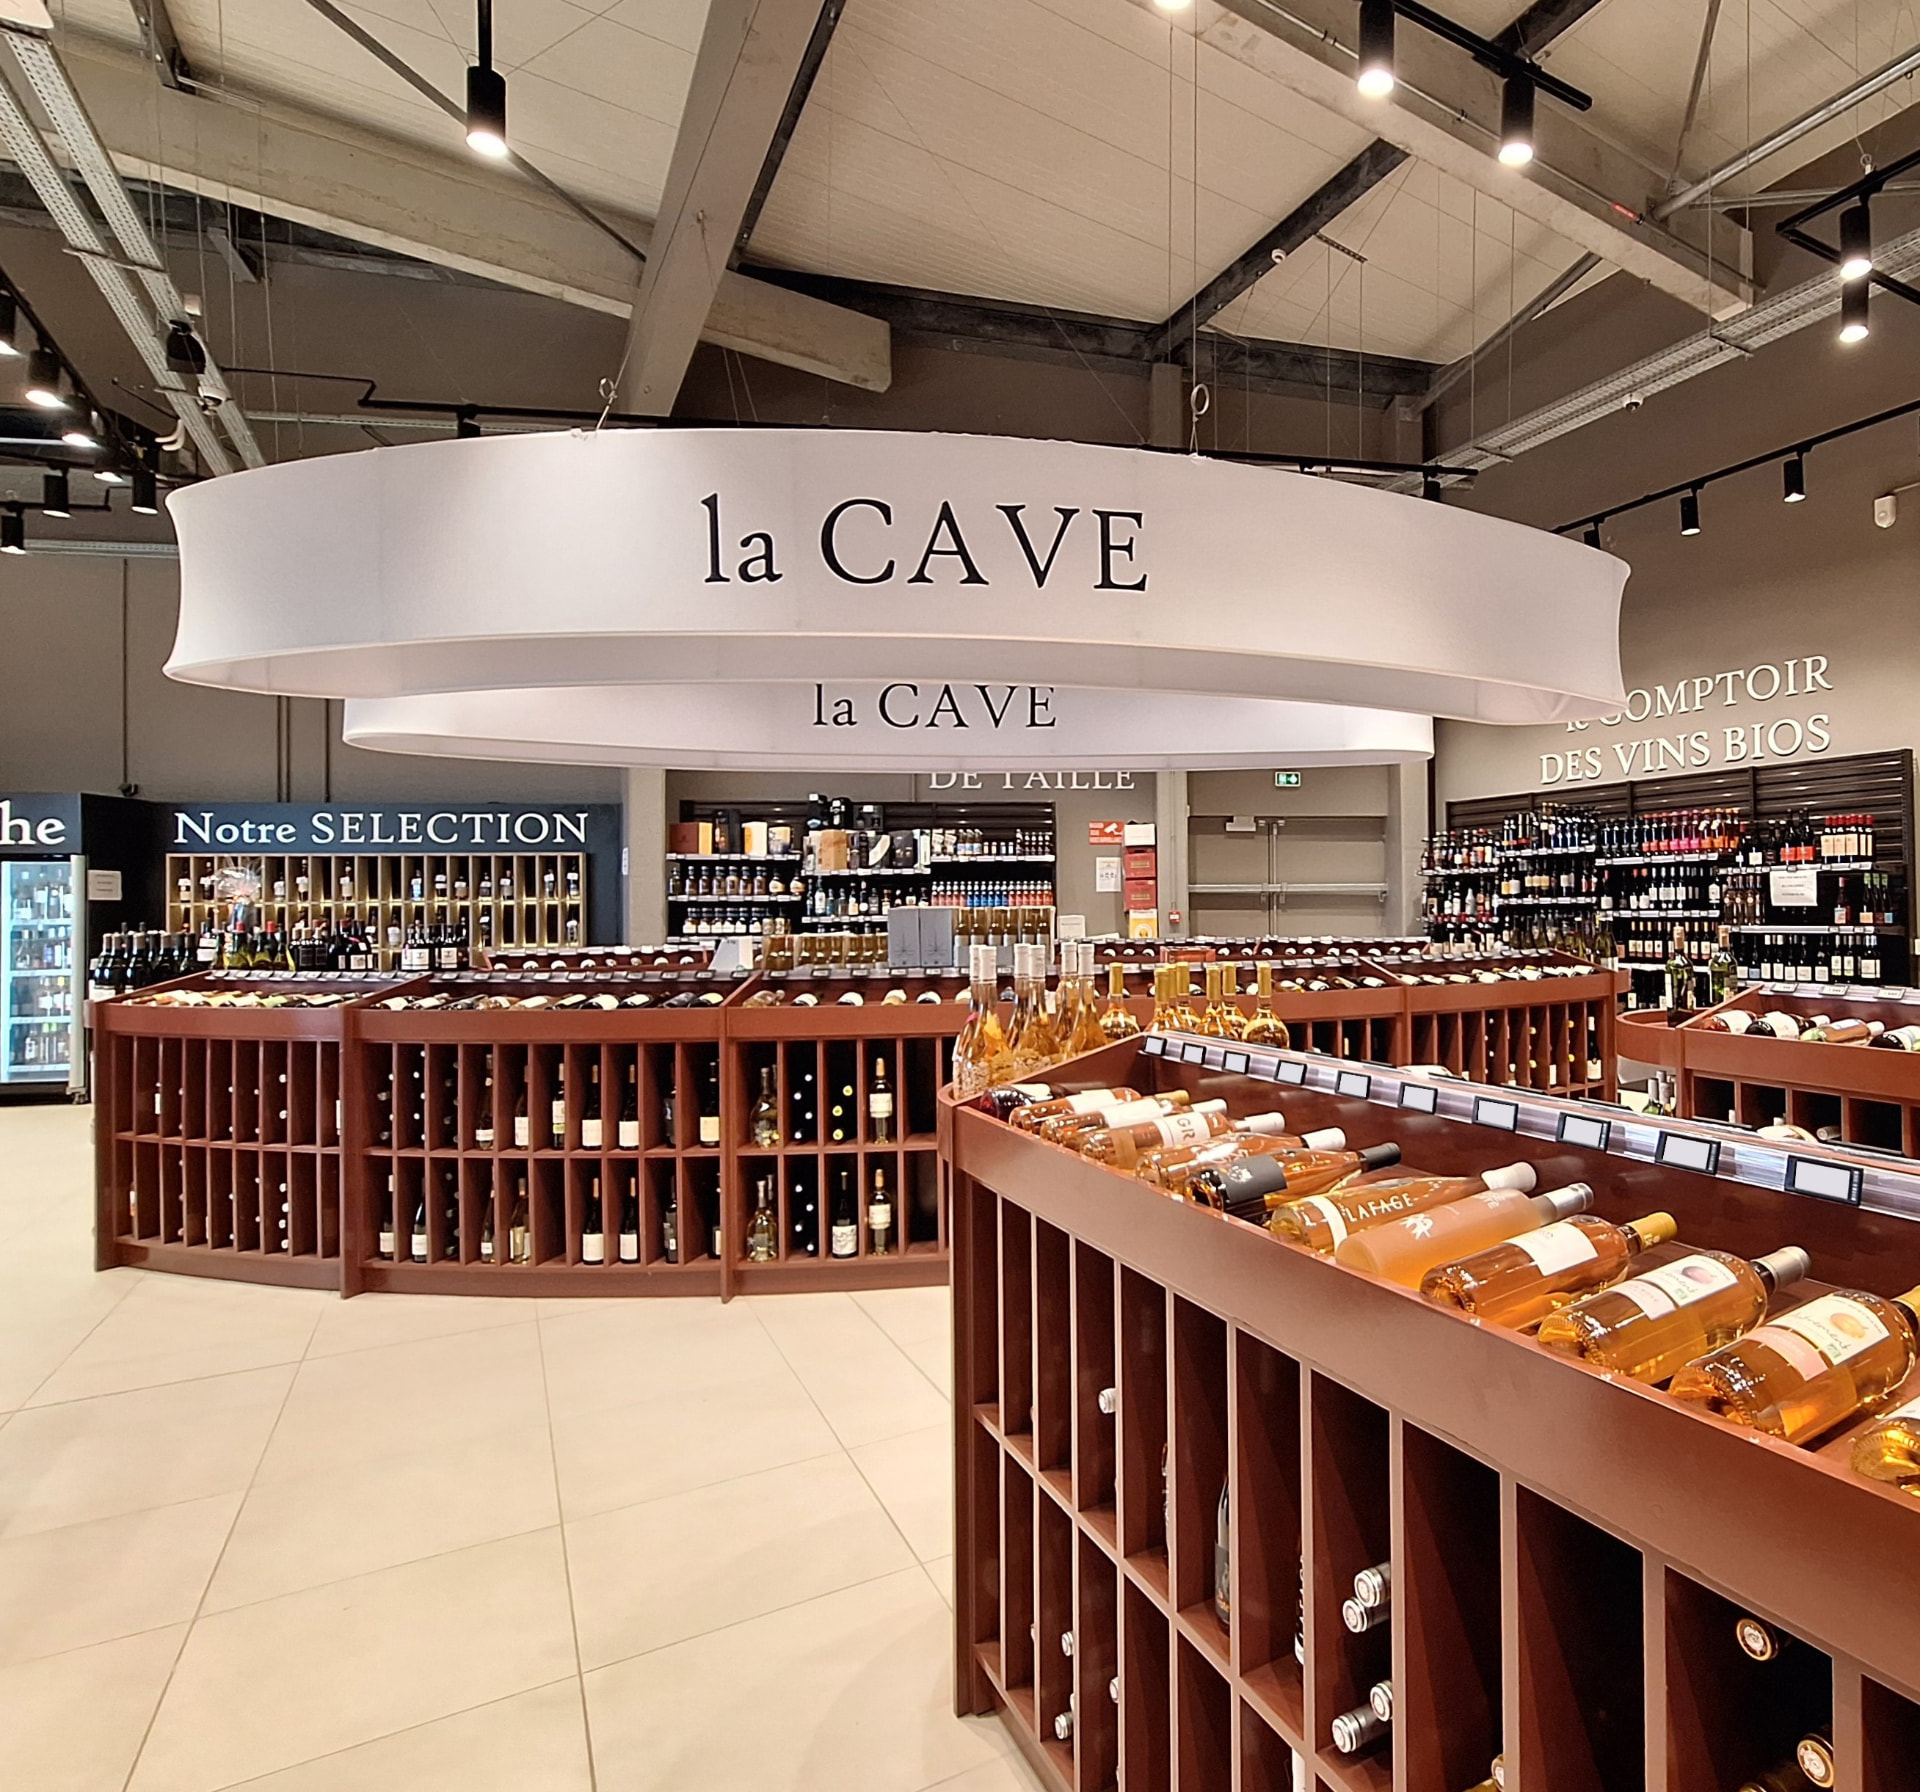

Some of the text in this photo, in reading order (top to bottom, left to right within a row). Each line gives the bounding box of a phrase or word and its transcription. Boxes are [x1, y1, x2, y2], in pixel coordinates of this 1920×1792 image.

[701, 493, 1147, 592] la CAVE
[813, 683, 1056, 729] la CAVE
[1540, 714, 1831, 785] DES VINS BIOS
[173, 812, 588, 844] Notre SELECTION
[1346, 1192, 1415, 1224] LAFAGE
